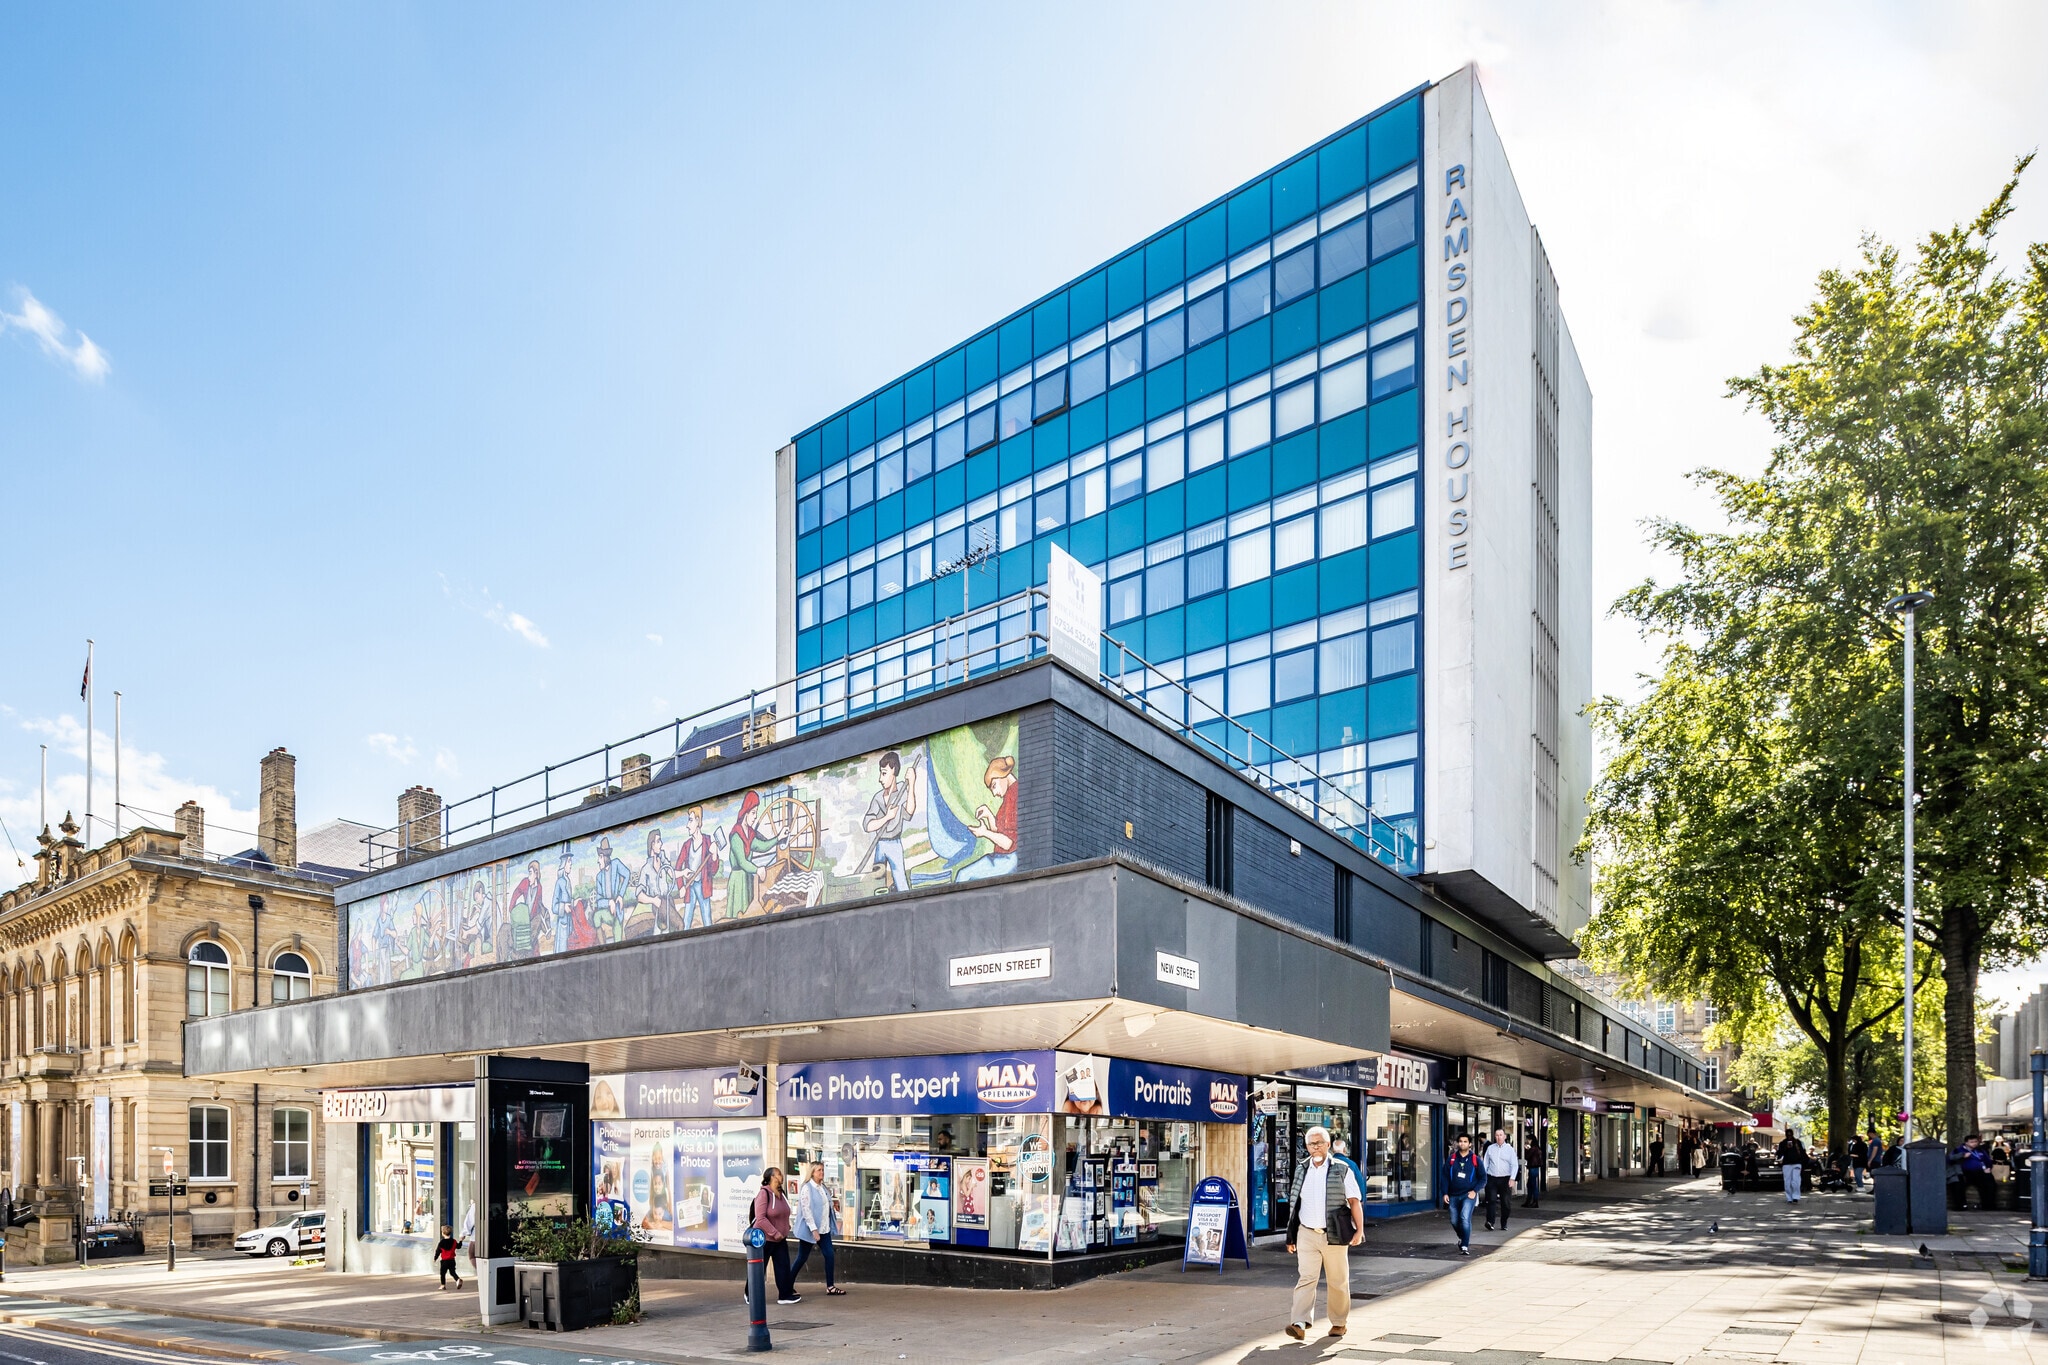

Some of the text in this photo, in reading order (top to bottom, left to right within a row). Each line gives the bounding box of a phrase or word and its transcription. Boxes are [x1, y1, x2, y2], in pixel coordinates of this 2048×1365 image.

[1444, 164, 1470, 571] RAMSDEN HOUSE
[957, 958, 1042, 977] RAMSDEN STREET
[1160, 962, 1196, 980] NEW STREET
[978, 1064, 1036, 1088] MAX
[639, 1082, 699, 1105] Portraits
[714, 1077, 738, 1096] MA
[790, 1071, 960, 1105] The Photo Expert
[983, 1090, 1031, 1098] SPIELMANN
[1134, 1075, 1192, 1106] Portraits
[1210, 1082, 1238, 1102] MAX
[326, 1092, 386, 1117] BETFRED
[600, 1127, 622, 1138] Photo
[634, 1127, 670, 1138] Portraits
[676, 1127, 716, 1140] Passport,
[602, 1140, 619, 1152] Gifts
[678, 1142, 714, 1152] Visa & ID
[1028, 1141, 1042, 1150] WE
[680, 1156, 711, 1168] Photos
[726, 1158, 750, 1168] Collect
